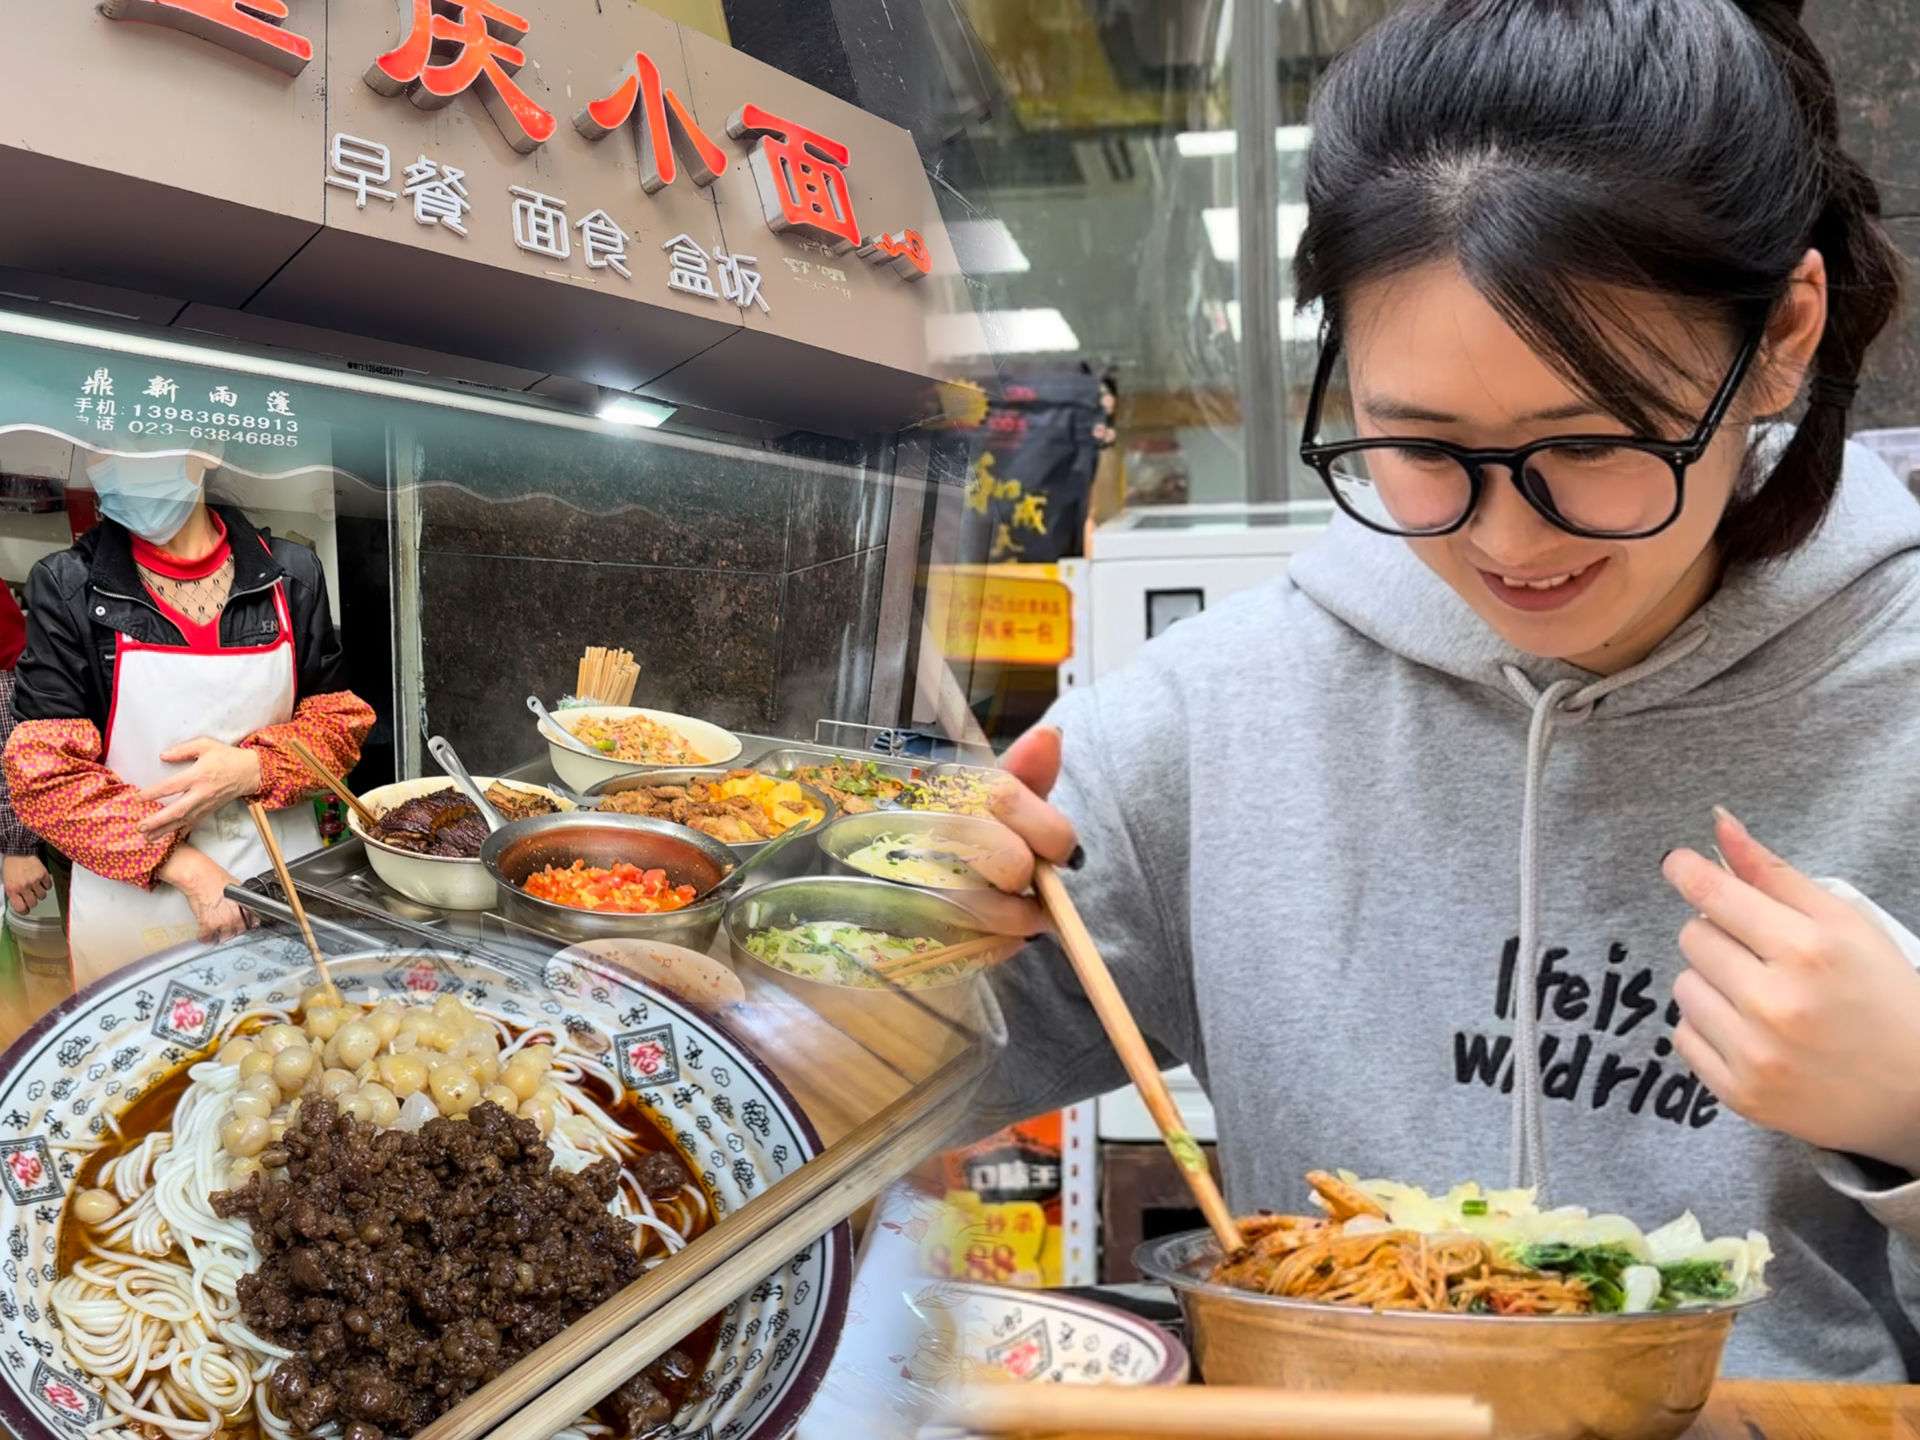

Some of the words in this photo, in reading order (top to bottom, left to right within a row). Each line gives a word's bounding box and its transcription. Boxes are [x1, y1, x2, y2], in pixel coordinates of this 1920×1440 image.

[103, 0, 862, 247] 庆小面
[325, 132, 471, 237] 早餐
[508, 184, 632, 279] 面食
[661, 233, 770, 314] 盒饭
[1494, 935, 1590, 1021] lfe
[1593, 942, 1657, 1036] is
